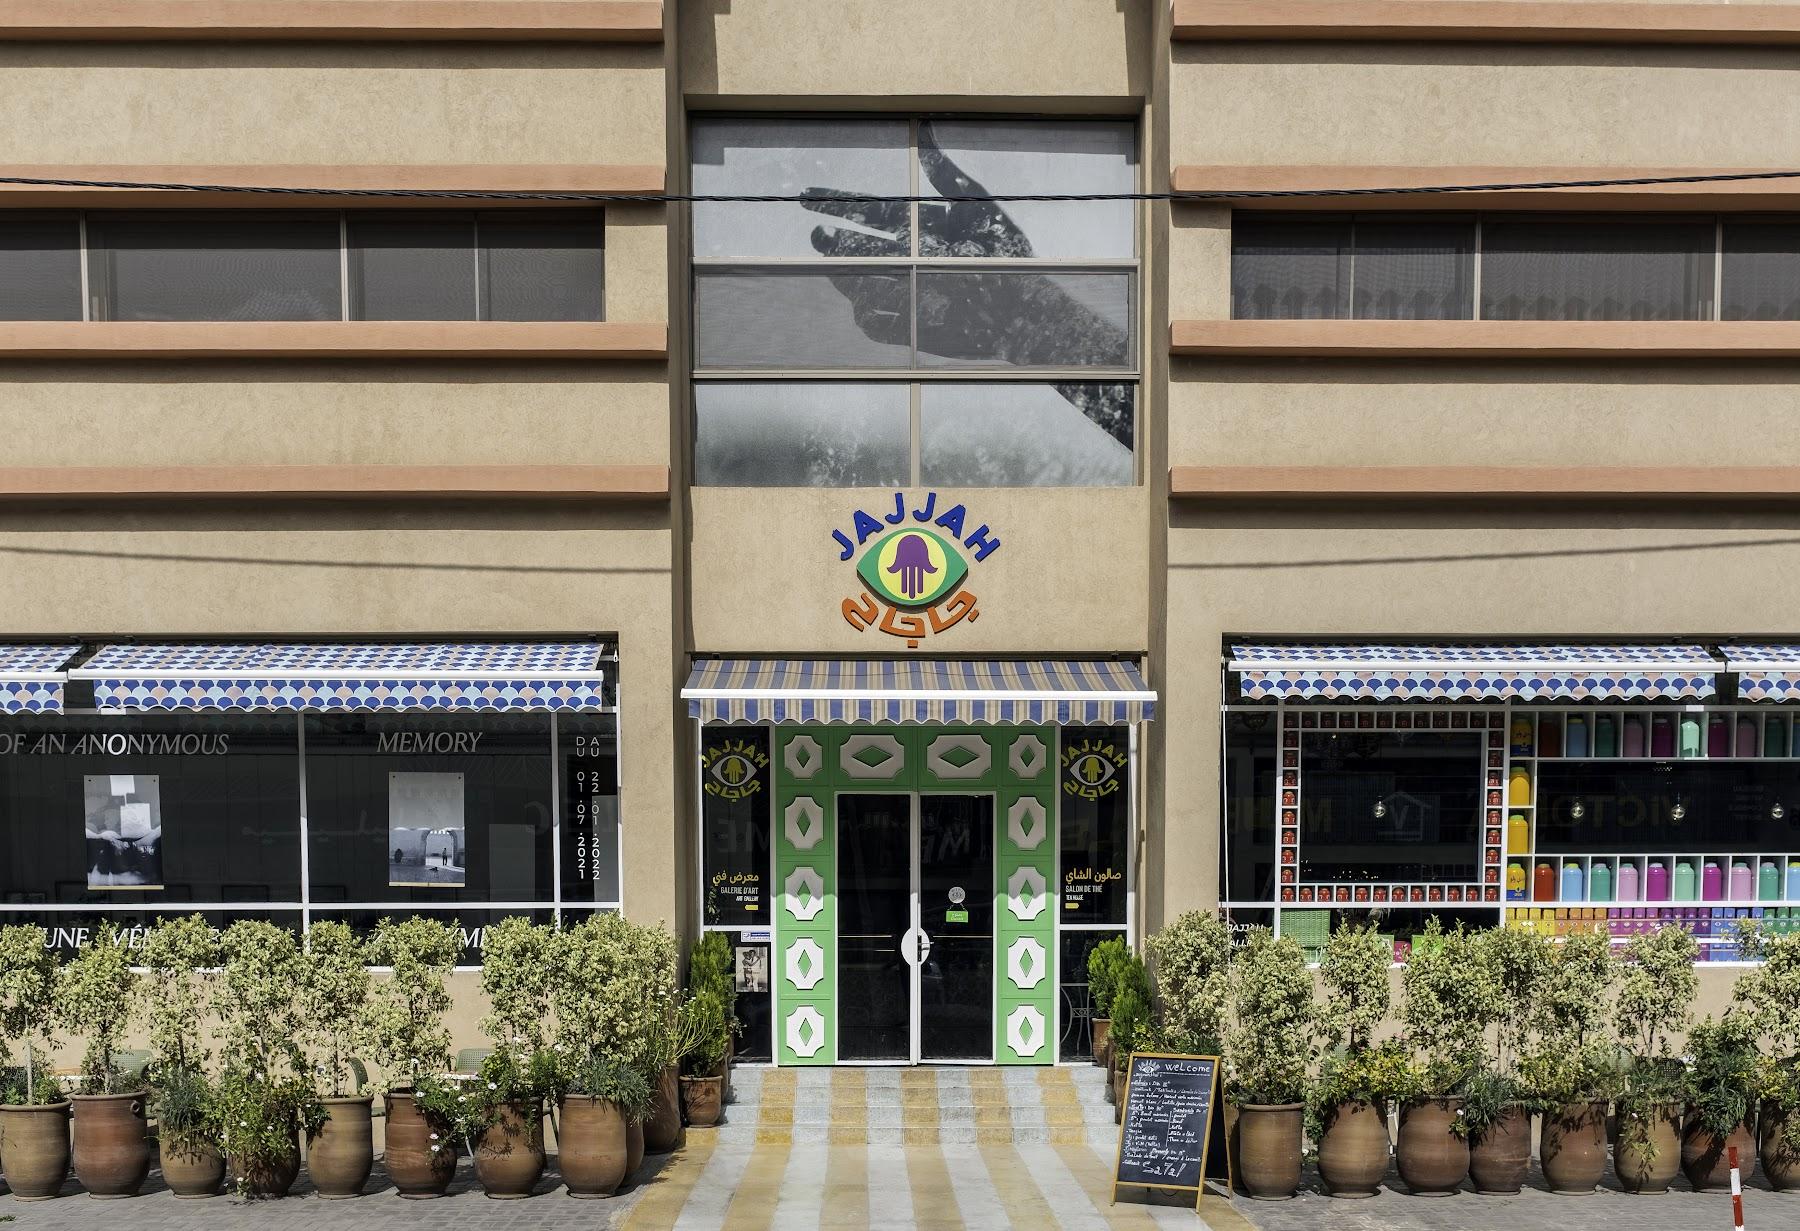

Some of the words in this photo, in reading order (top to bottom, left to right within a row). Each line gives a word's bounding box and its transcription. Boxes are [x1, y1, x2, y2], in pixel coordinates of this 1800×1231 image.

[832, 492, 1000, 563] JAJJAH
[0, 733, 26, 755] OF
[31, 734, 66, 755] AN
[71, 733, 229, 755] ANONYMOUS
[376, 732, 483, 753] MEMORY
[699, 739, 769, 768] JAJJAH
[1060, 739, 1127, 768] JAJJAH
[730, 872, 760, 884] معرض
[1065, 868, 1092, 884] الشاي
[1065, 885, 1083, 893] SALON
[1084, 885, 1091, 893] DE
